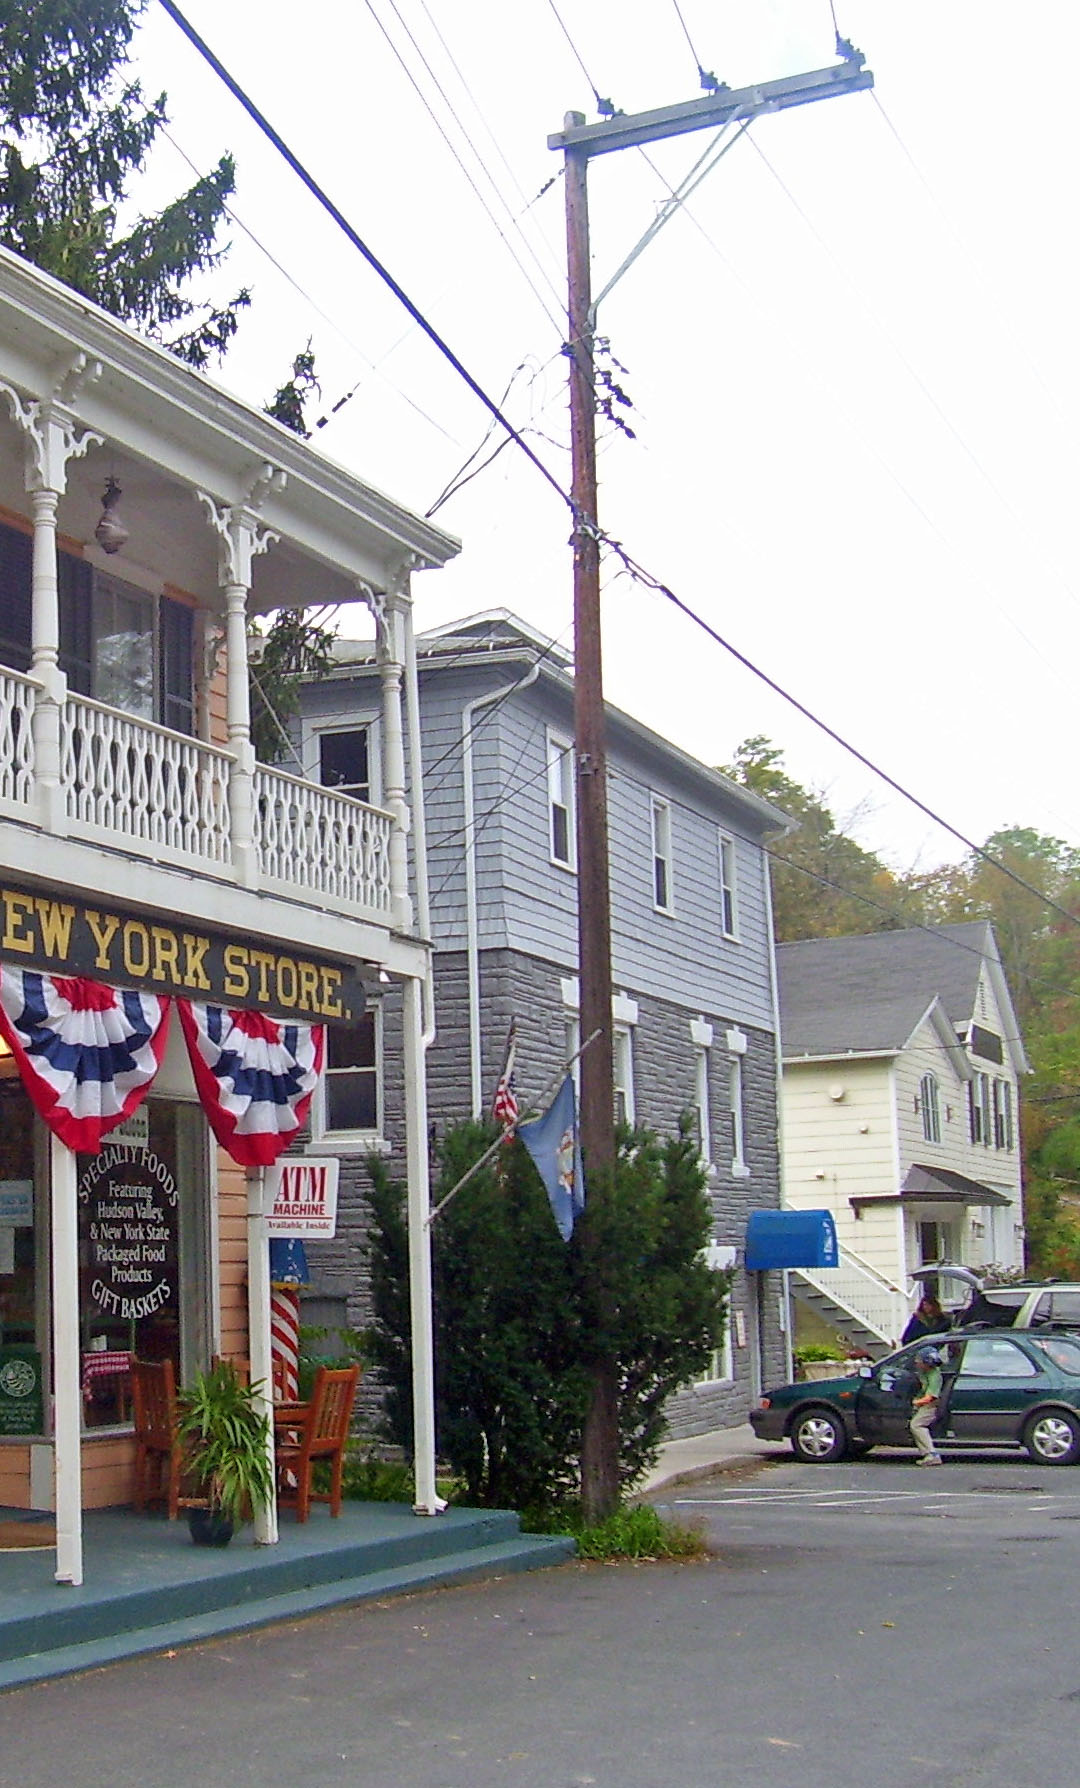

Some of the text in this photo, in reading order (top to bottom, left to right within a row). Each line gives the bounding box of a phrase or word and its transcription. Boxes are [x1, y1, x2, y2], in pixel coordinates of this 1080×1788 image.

[85, 910, 212, 991] YORK
[223, 944, 352, 1020] STORE.
[79, 1145, 180, 1207] SPECIALTY FOODS
[274, 1166, 327, 1202] ATM
[109, 1180, 153, 1202] Featuring
[97, 1201, 134, 1219] Hudson
[273, 1203, 326, 1215] MACHINE
[90, 1222, 170, 1241] & New York State
[268, 1220, 330, 1230] Available Inside
[96, 1244, 166, 1265] Packaged Food
[111, 1265, 153, 1282] Products
[91, 1278, 171, 1320] GIFT BASKETS
